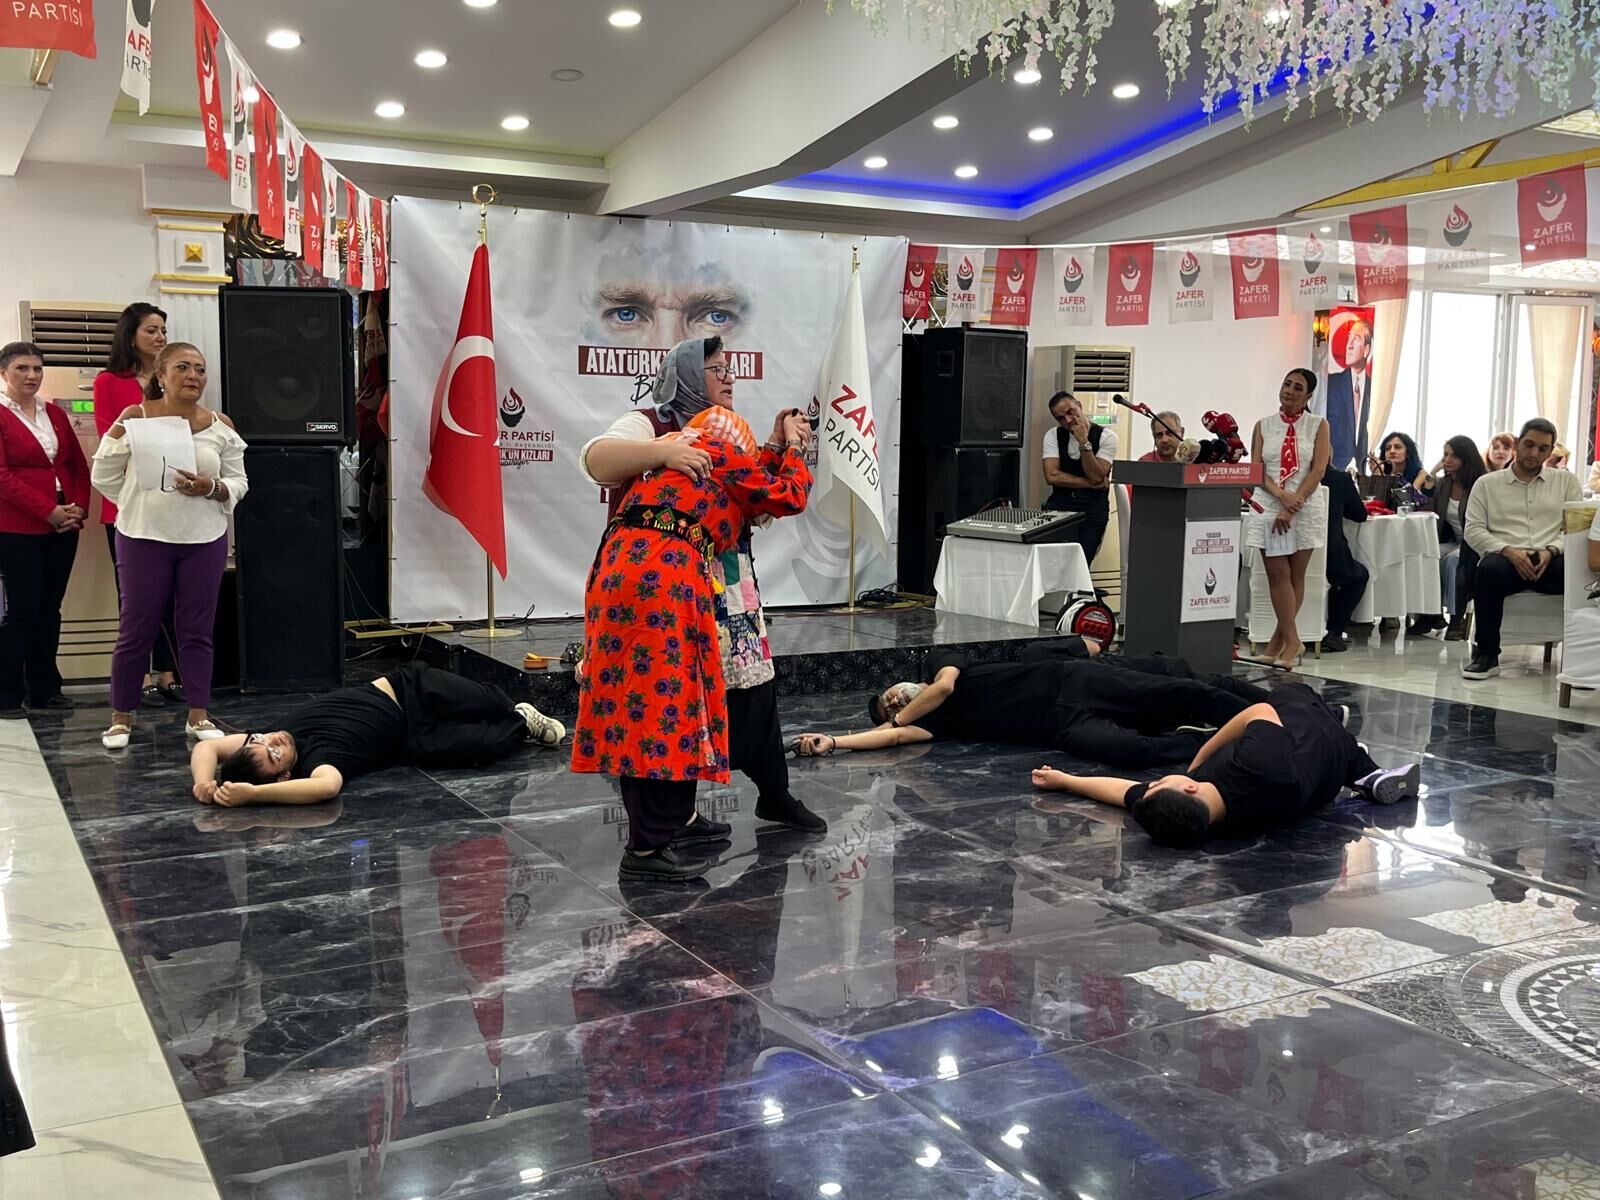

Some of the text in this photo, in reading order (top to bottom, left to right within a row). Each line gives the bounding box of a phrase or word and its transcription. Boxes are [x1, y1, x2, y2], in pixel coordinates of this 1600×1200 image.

[1533, 222, 1573, 239] ZAFER
[1363, 265, 1398, 278] ZAFER
[1299, 275, 1328, 288] ZAFER
[1176, 289, 1204, 300] ZAFER
[1239, 284, 1269, 295] ZAFER
[952, 293, 976, 301] ZAFER
[1001, 296, 1025, 305] ZAFER
[1059, 296, 1086, 305] ZAFER
[1116, 294, 1143, 304] ZAFER
[586, 347, 667, 375] ATATÜRK'
[830, 383, 879, 463] ZAF
[511, 430, 554, 442] PARTİSİ
[521, 450, 550, 461] KIZLARI
[1209, 466, 1250, 475] ZAFER PARTİSİ
[1190, 597, 1208, 606] ZAFER
